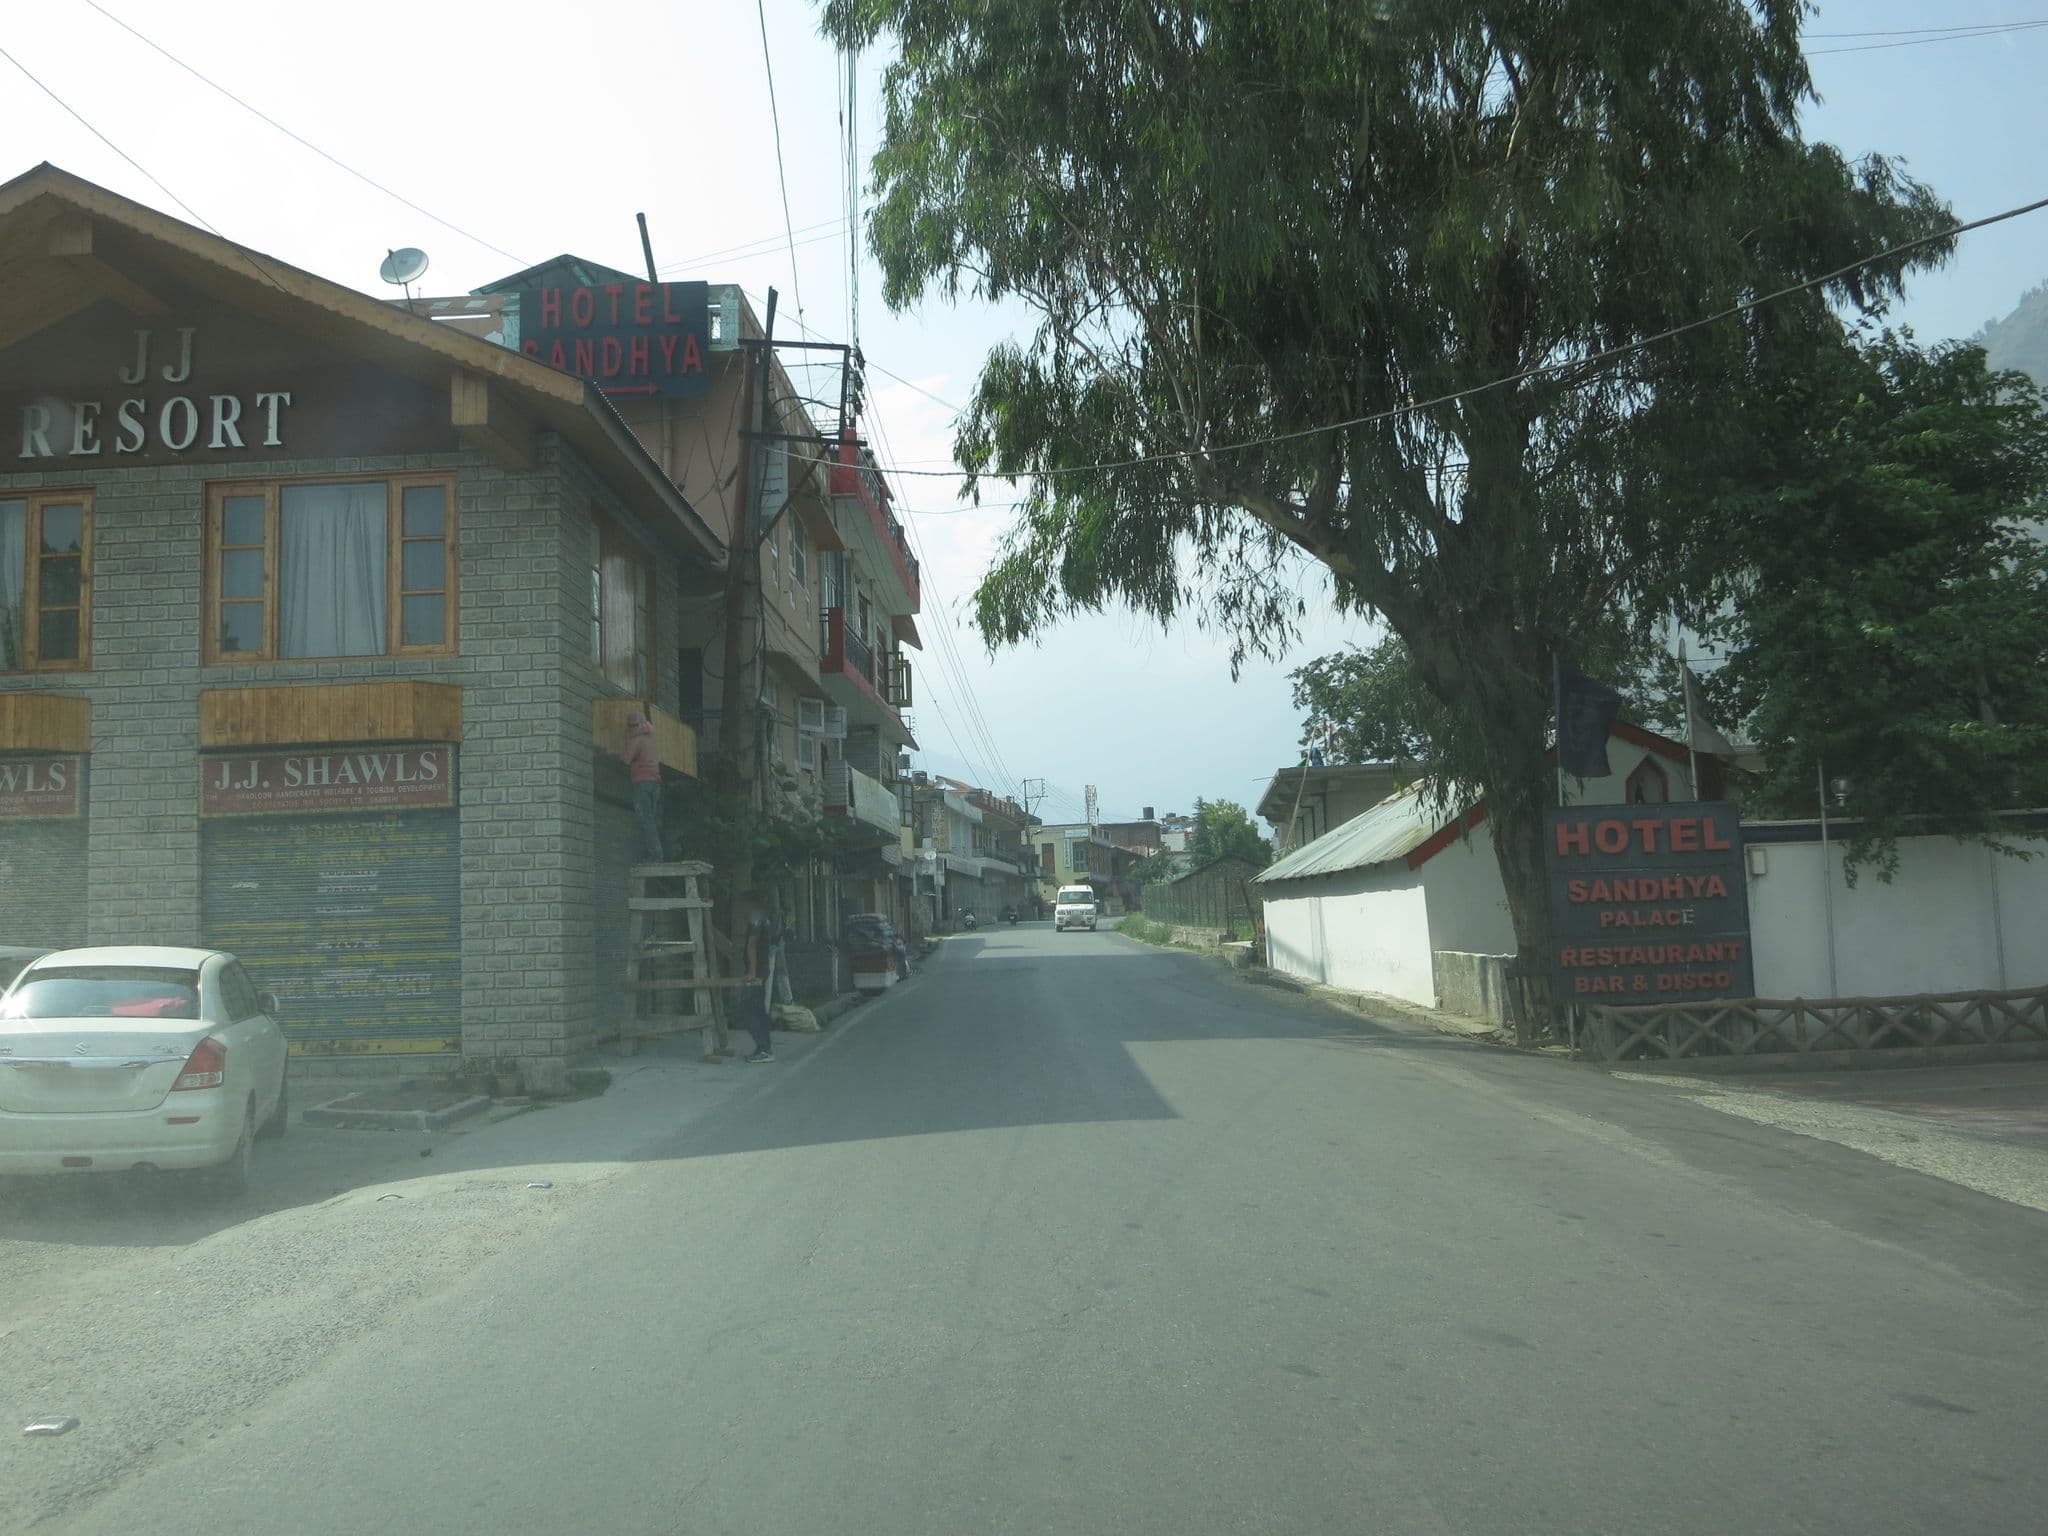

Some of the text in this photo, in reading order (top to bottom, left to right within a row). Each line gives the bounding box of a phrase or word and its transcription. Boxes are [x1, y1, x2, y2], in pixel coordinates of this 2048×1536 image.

[541, 283, 681, 329] HOTEL
[118, 327, 196, 385] JJ
[18, 392, 291, 458] RESORT
[214, 751, 439, 790] J.J. SHAWLS
[1556, 817, 1732, 856] HOTEL
[1567, 875, 1729, 903] SANDHYA
[1600, 908, 1696, 928] PALACE
[1560, 943, 1742, 967] RESTAURANT
[1575, 971, 1732, 993] BAR & DISCO
